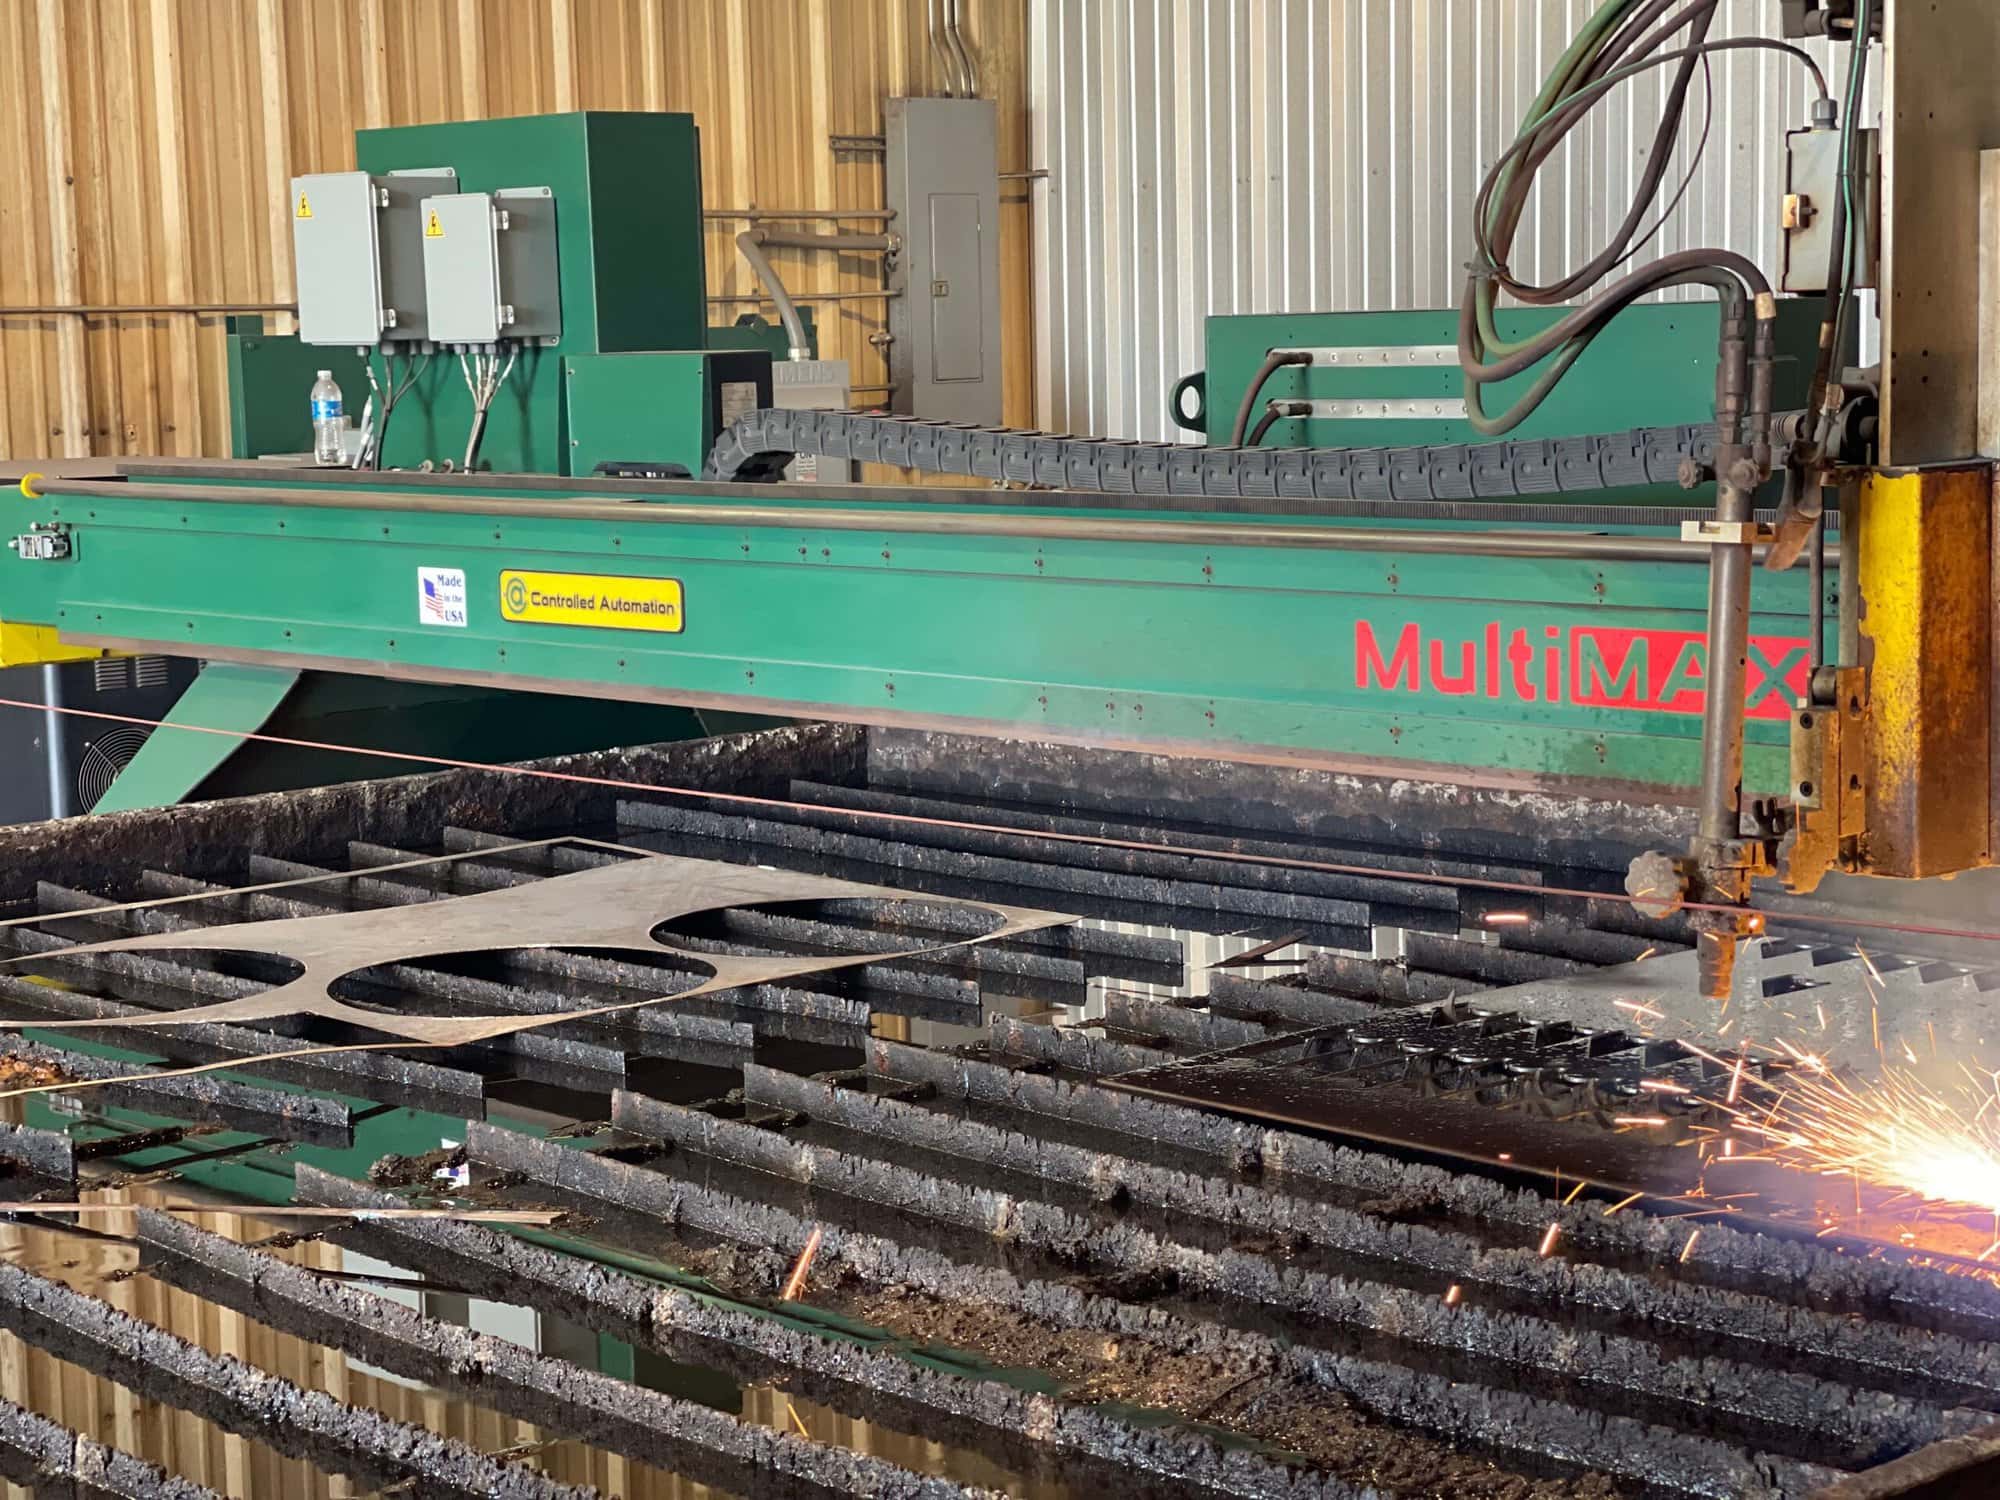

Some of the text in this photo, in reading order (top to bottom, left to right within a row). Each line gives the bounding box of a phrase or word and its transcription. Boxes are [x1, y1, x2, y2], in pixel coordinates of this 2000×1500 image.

[437, 574, 462, 587] Made
[531, 591, 595, 610] Controlled
[600, 595, 675, 615] Automation
[444, 609, 464, 623] USA
